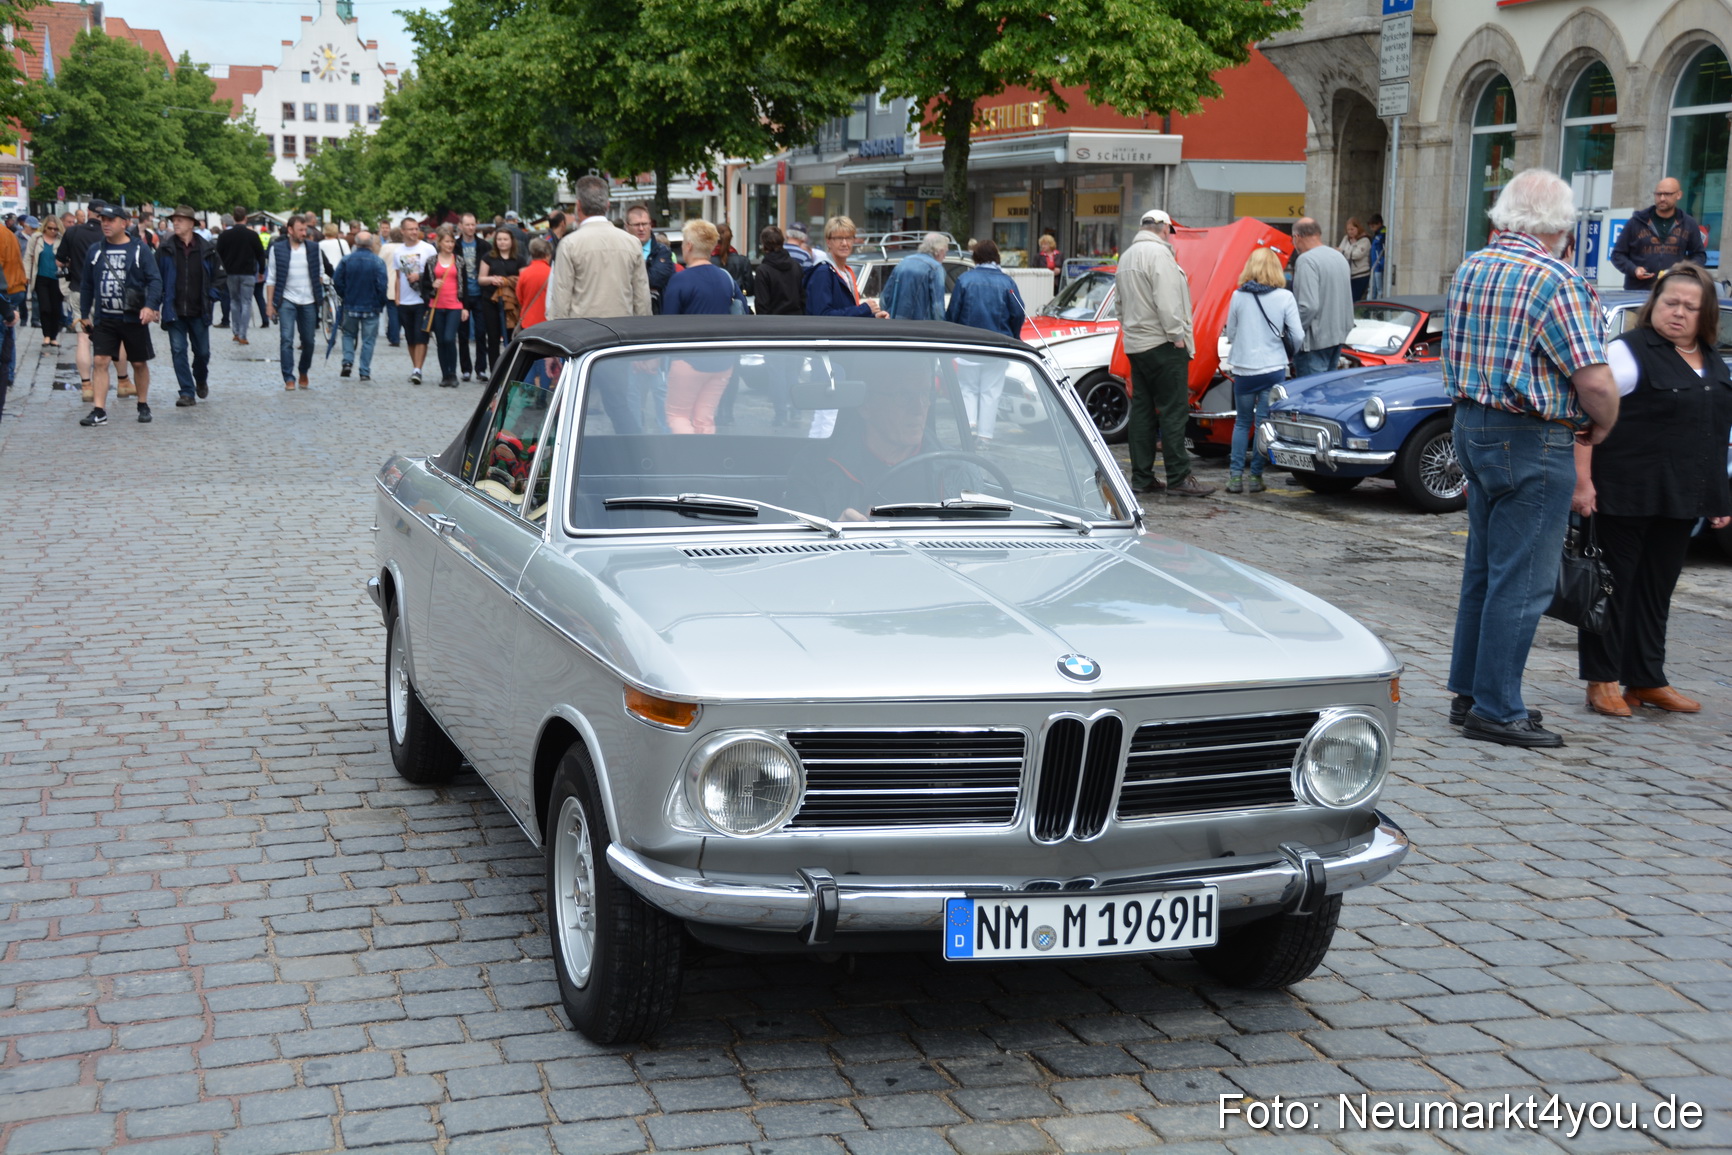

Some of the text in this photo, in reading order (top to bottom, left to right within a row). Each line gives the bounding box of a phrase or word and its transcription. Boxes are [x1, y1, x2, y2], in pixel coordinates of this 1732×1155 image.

[1098, 152, 1152, 161] SCHLIERF
[977, 893, 1213, 950] NM M 1969H
[955, 935, 965, 947] D
